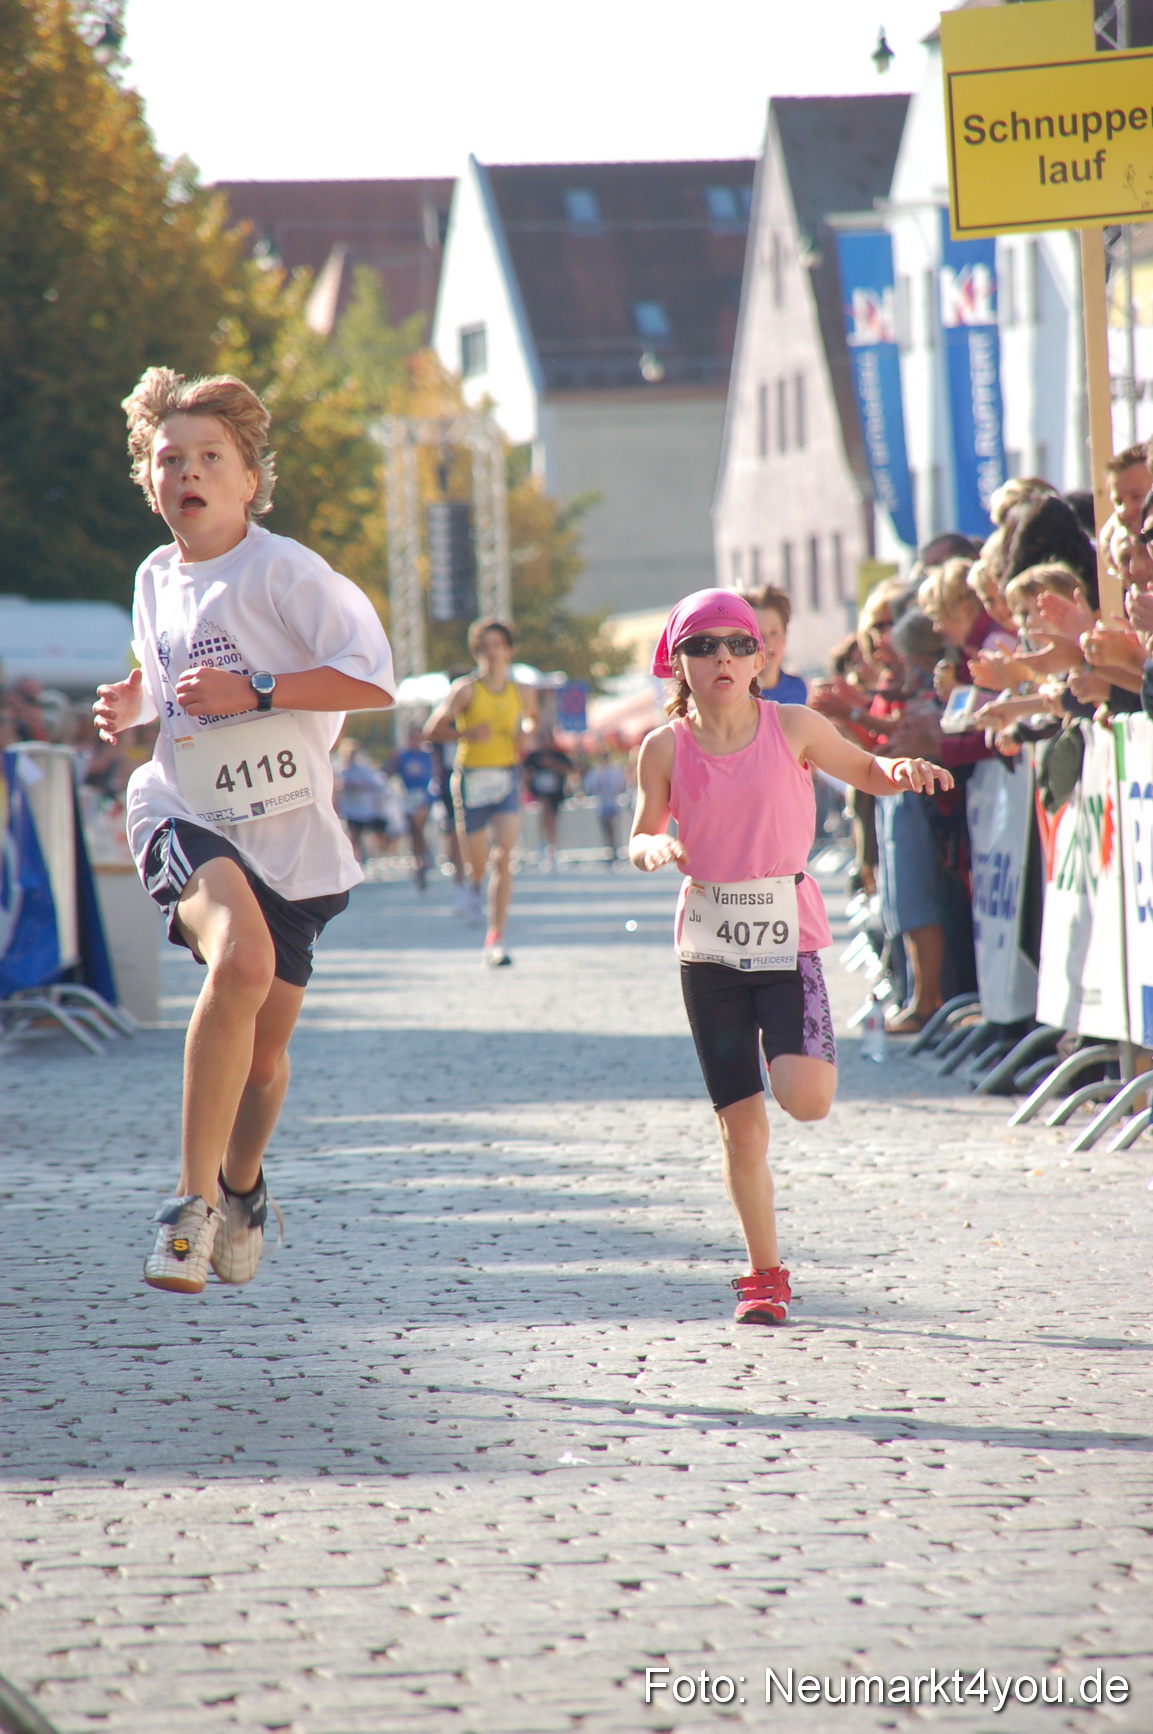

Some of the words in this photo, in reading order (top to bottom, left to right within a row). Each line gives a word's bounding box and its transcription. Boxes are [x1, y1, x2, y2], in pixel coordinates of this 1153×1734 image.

[1039, 149, 1106, 185] lauf
[215, 750, 297, 792] 4118
[265, 787, 310, 808] PFLEIDERER
[712, 885, 774, 905] Vanessa
[689, 909, 702, 922] Ju
[716, 920, 789, 946] 4079
[752, 956, 795, 965] PFLEIDERER
